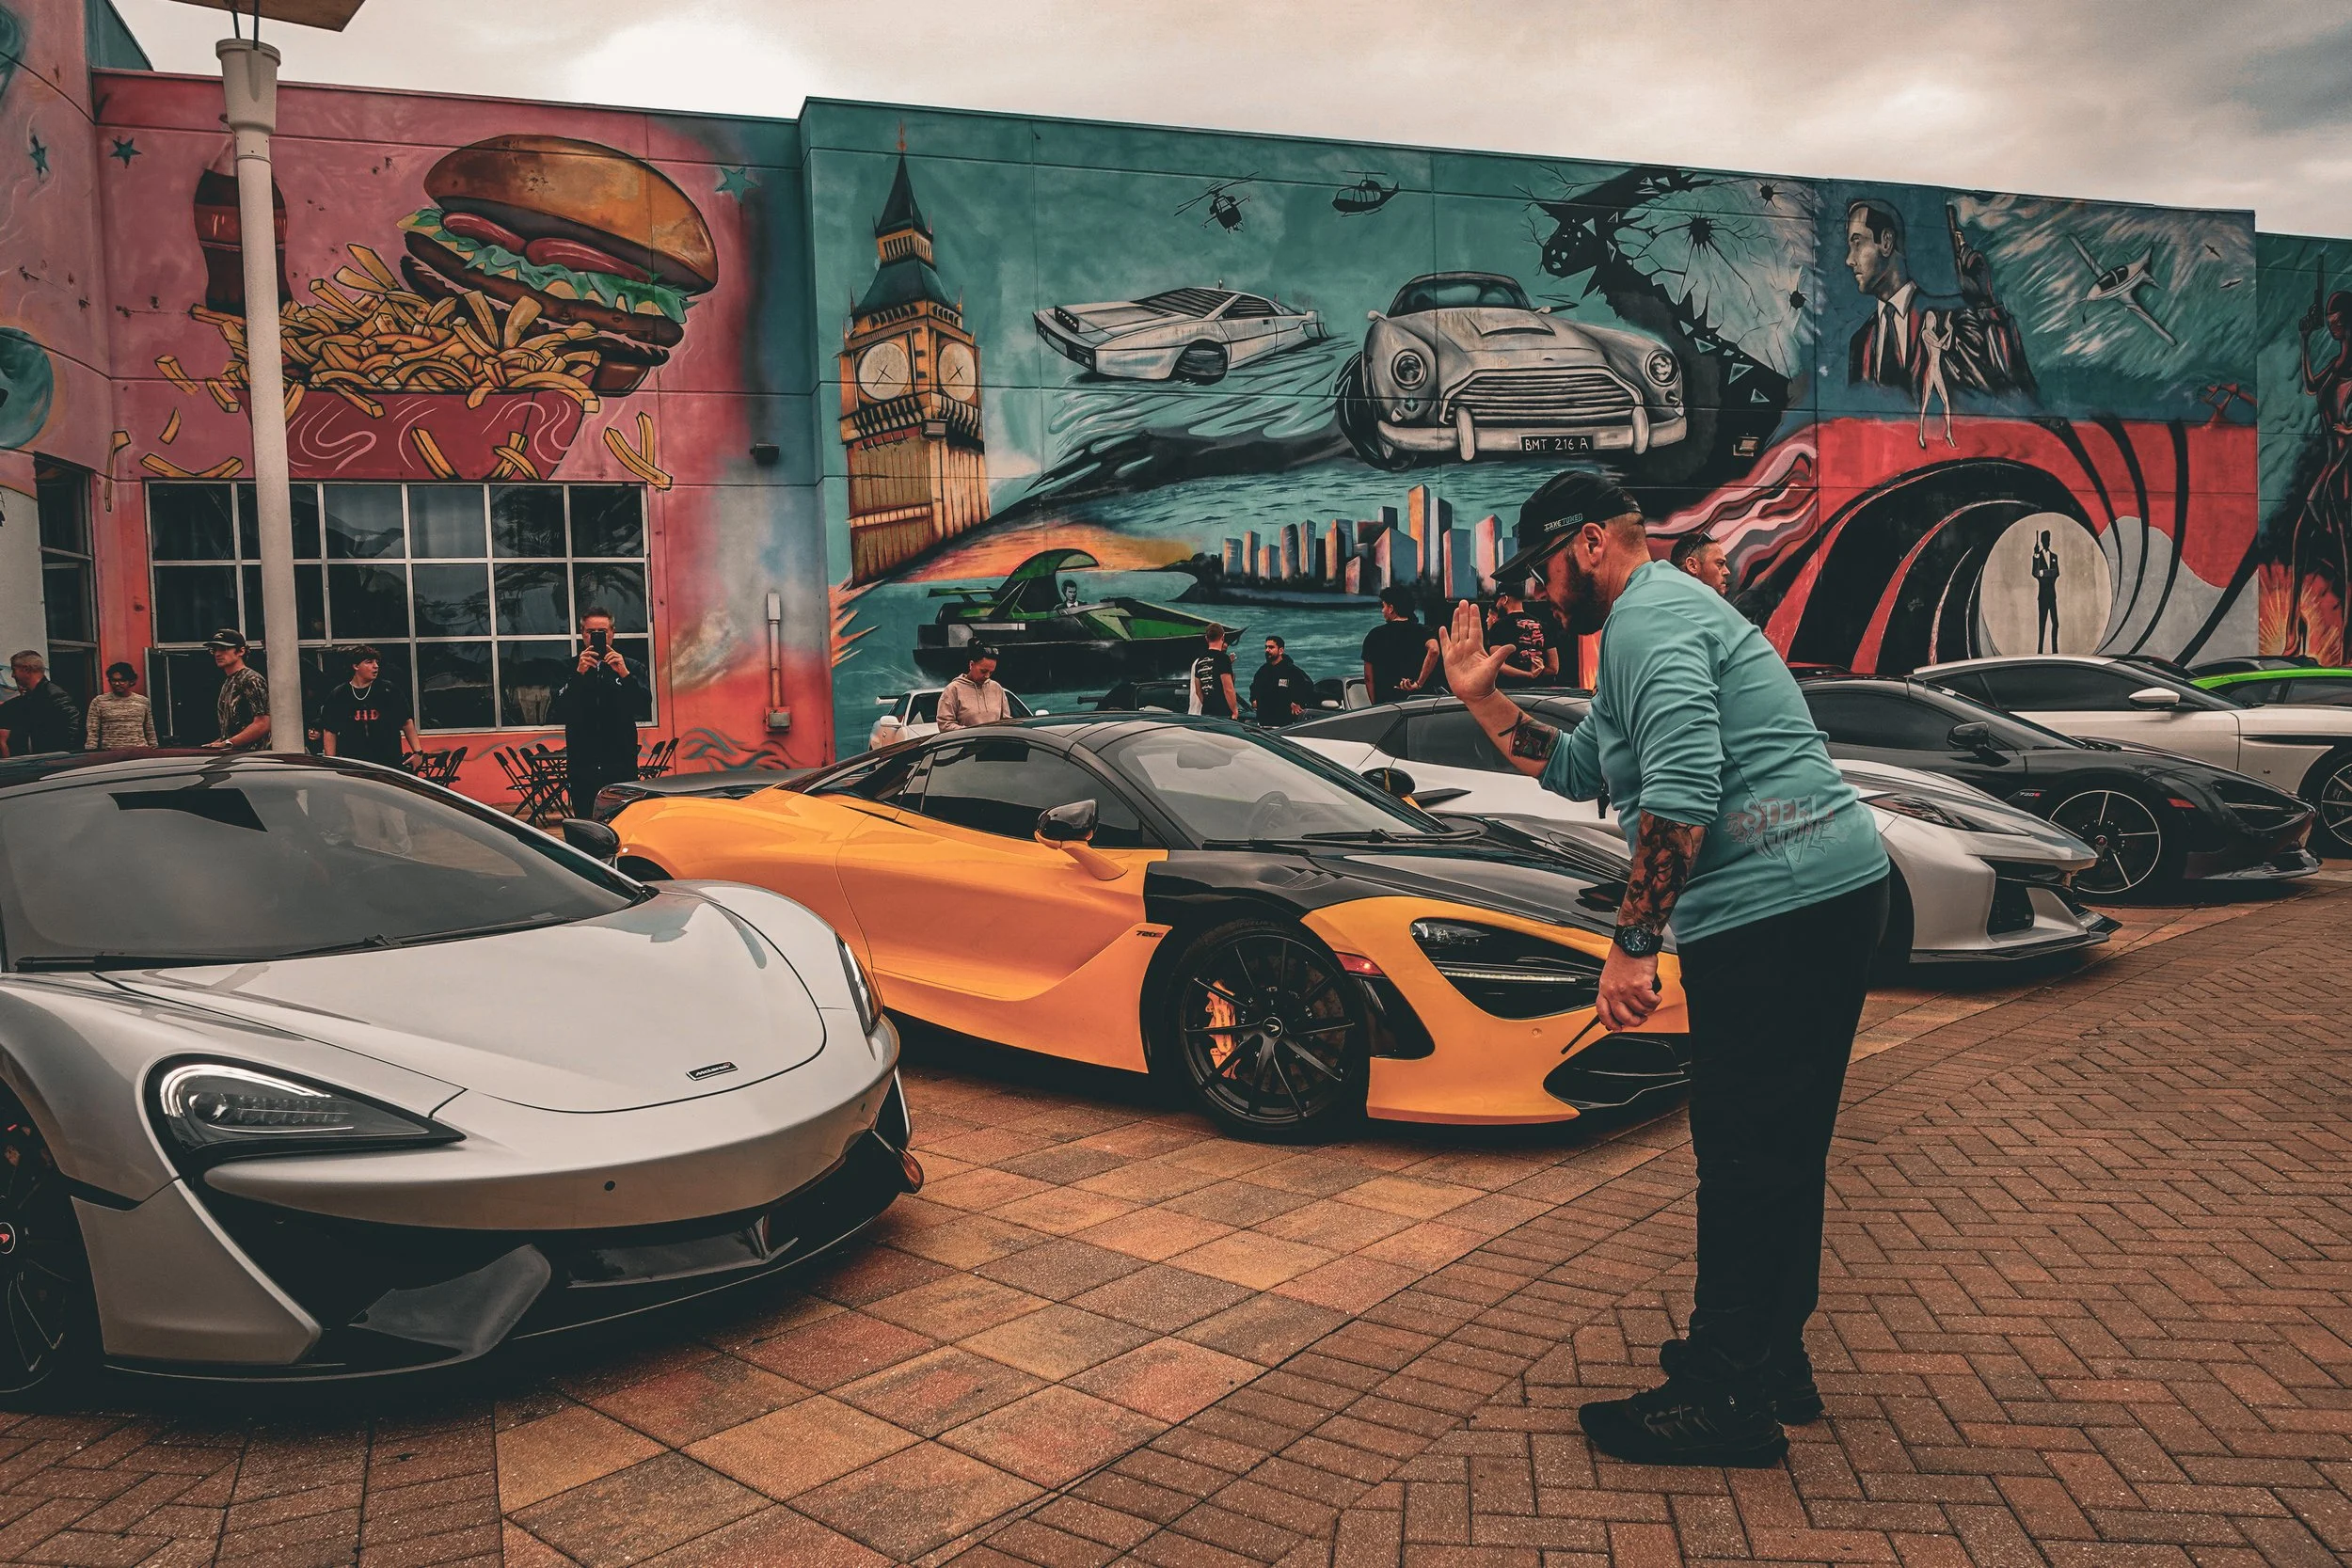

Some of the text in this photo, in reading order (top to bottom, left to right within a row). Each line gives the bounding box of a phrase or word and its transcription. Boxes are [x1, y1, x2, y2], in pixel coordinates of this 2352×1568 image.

[1525, 436, 1589, 451] BMT 216 A
[1136, 929, 1164, 939] 720S
[695, 1065, 730, 1077] McLaren
